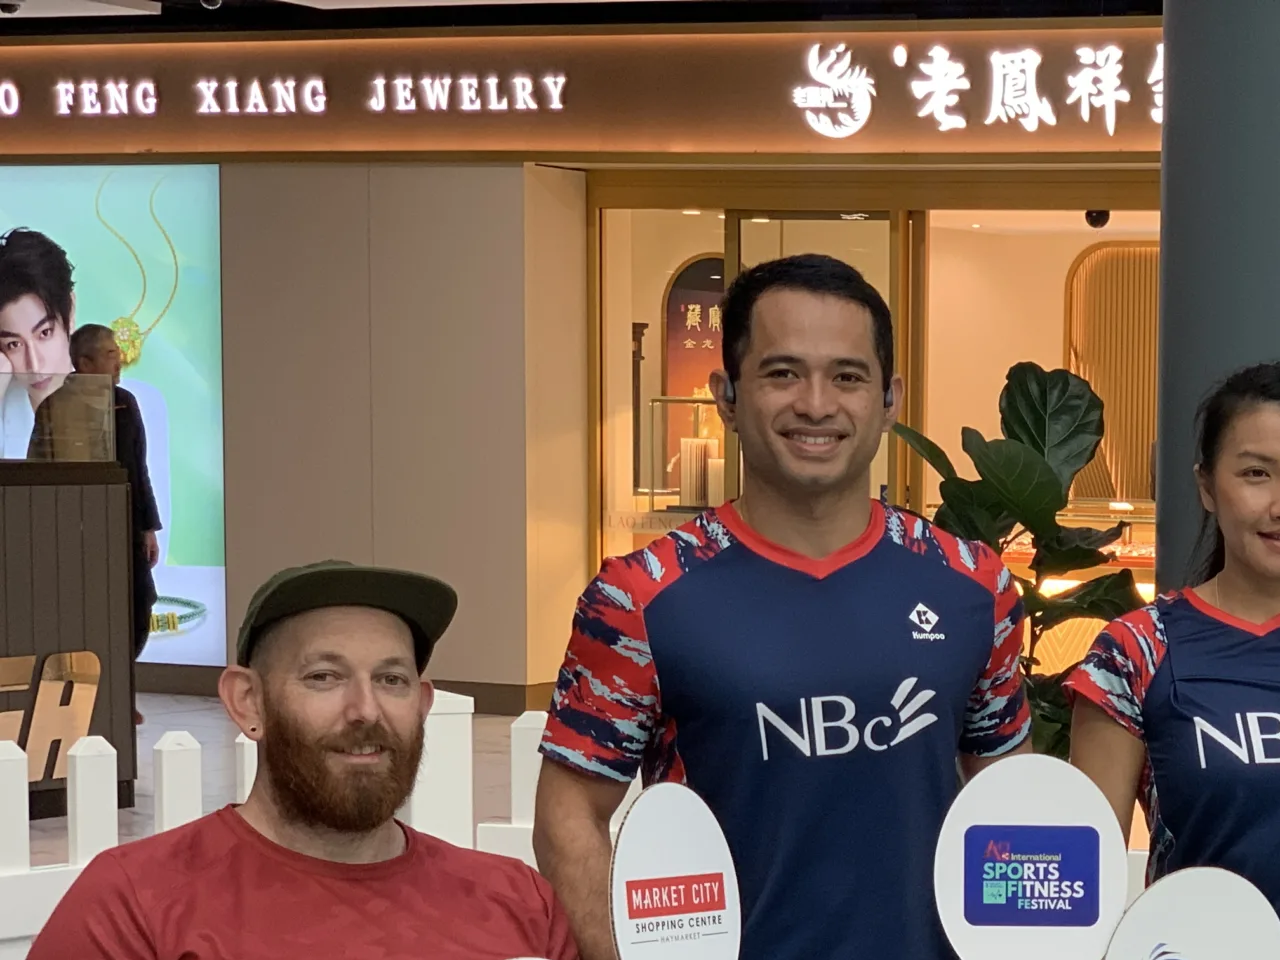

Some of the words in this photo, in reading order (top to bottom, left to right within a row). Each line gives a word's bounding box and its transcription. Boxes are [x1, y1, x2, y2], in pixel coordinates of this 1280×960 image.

[56, 80, 158, 115] FENG
[197, 78, 328, 114] XIANG
[368, 75, 567, 112] JEWELRY
[911, 43, 1163, 137] 老鳳祥
[1010, 852, 1062, 861] International
[982, 861, 1060, 880] SPORTS
[631, 884, 686, 911] MARKET
[691, 881, 720, 905] CITY
[1007, 880, 1085, 898] FITNESS
[1017, 898, 1072, 910] FESTIVAL
[635, 918, 685, 934] SHOPPING
[688, 914, 723, 928] CENTRE
[660, 931, 701, 944] HAYMARKET
